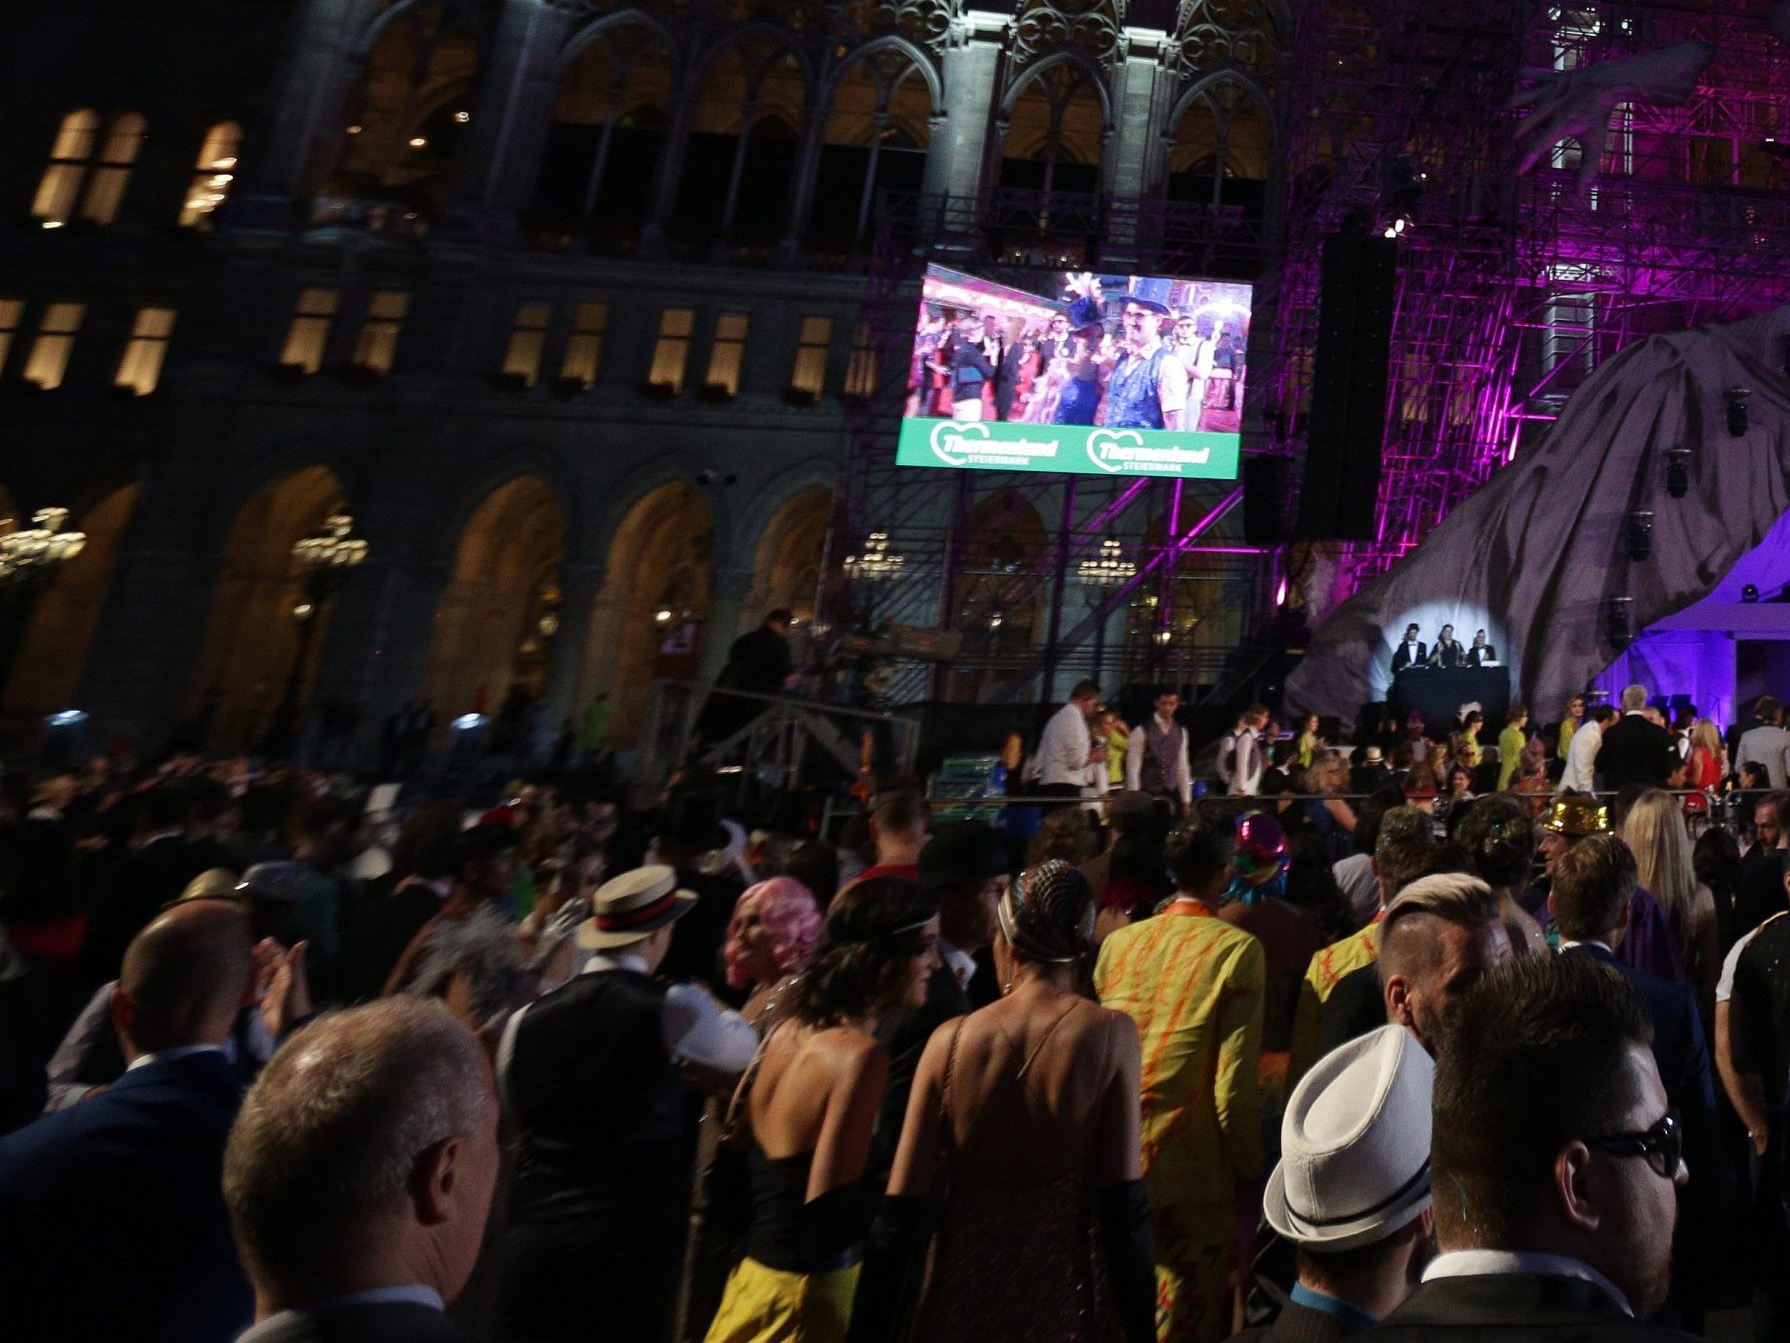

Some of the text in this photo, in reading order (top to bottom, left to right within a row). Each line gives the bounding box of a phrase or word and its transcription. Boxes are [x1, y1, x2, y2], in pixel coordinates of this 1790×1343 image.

[943, 435, 1059, 458] Thermenland
[1099, 442, 1210, 464] Thermenland
[967, 455, 1030, 466] STEIERMARK
[1123, 462, 1182, 473] STEIERMARK
